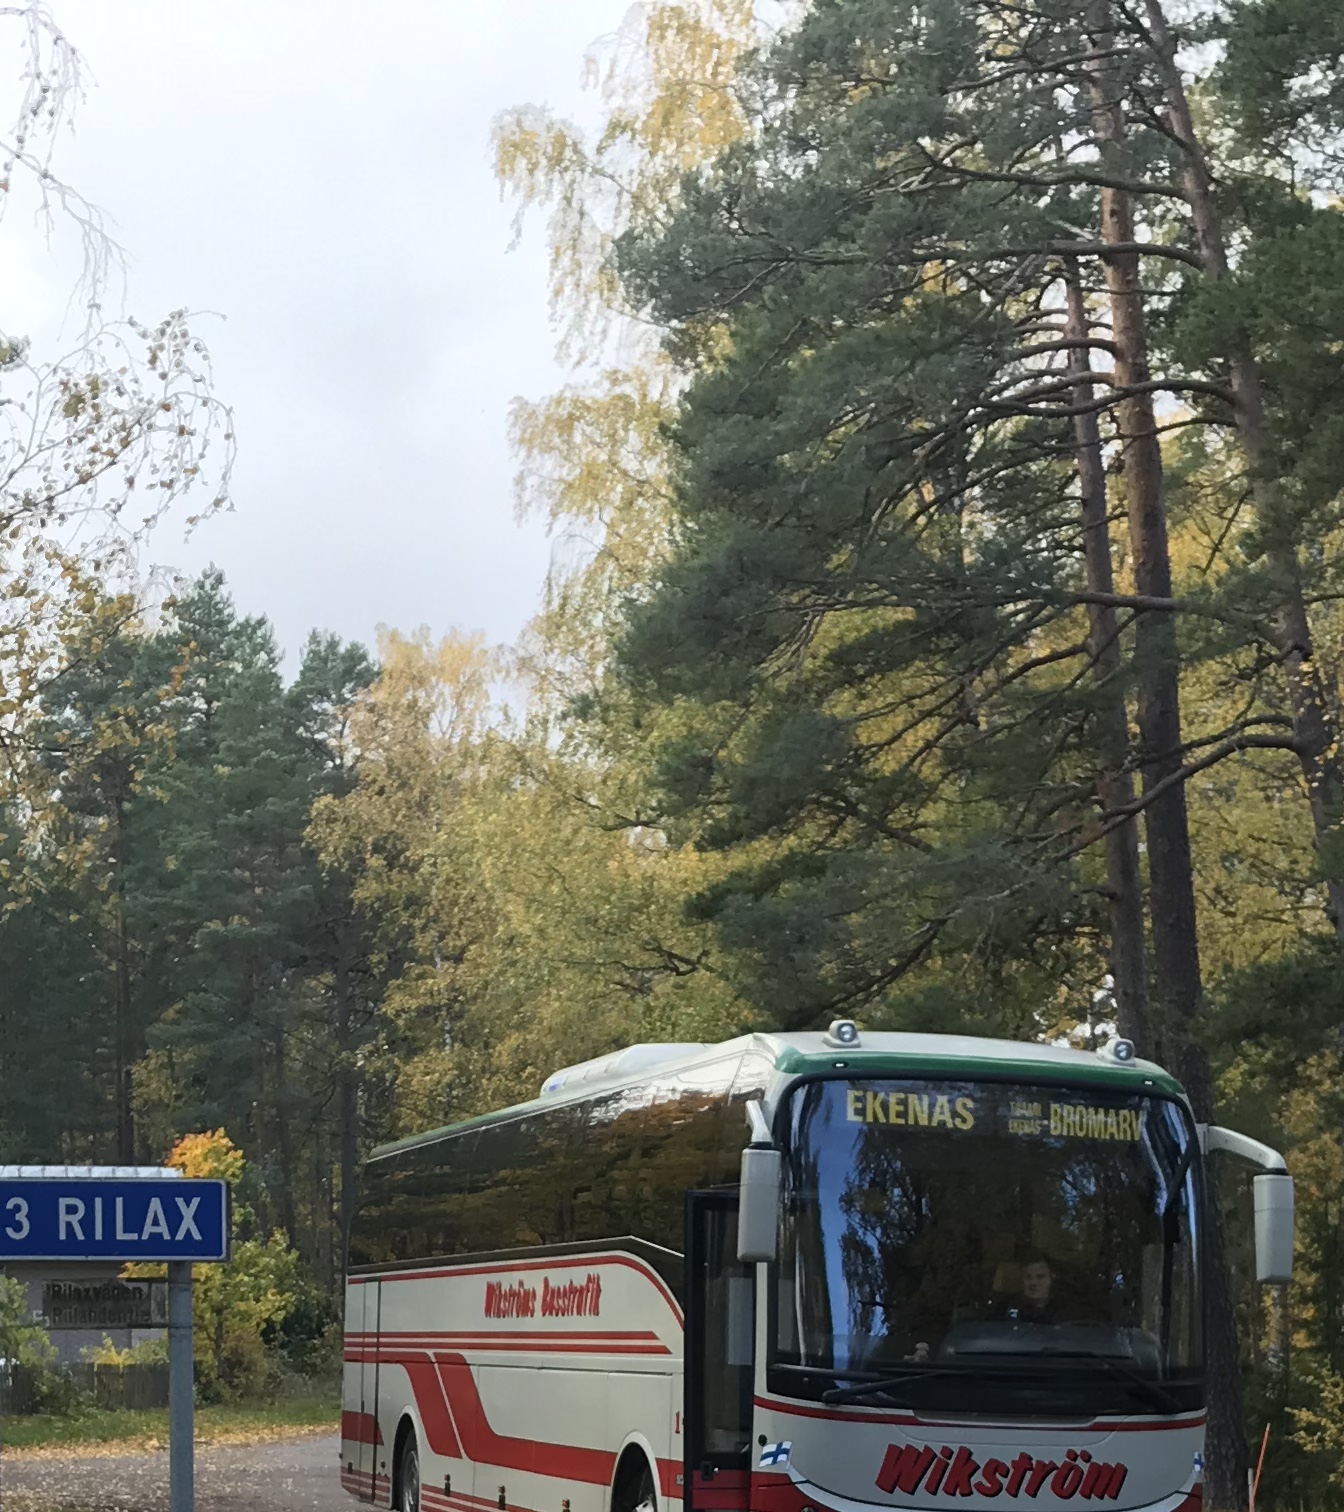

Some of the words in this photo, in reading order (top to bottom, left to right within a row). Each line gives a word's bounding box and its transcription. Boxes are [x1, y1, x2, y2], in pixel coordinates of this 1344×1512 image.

[1050, 1103, 1143, 1141] BROMARV
[5, 1196, 31, 1240] 3
[58, 1196, 203, 1241] RILAX
[874, 1443, 1128, 1501] Wikström
